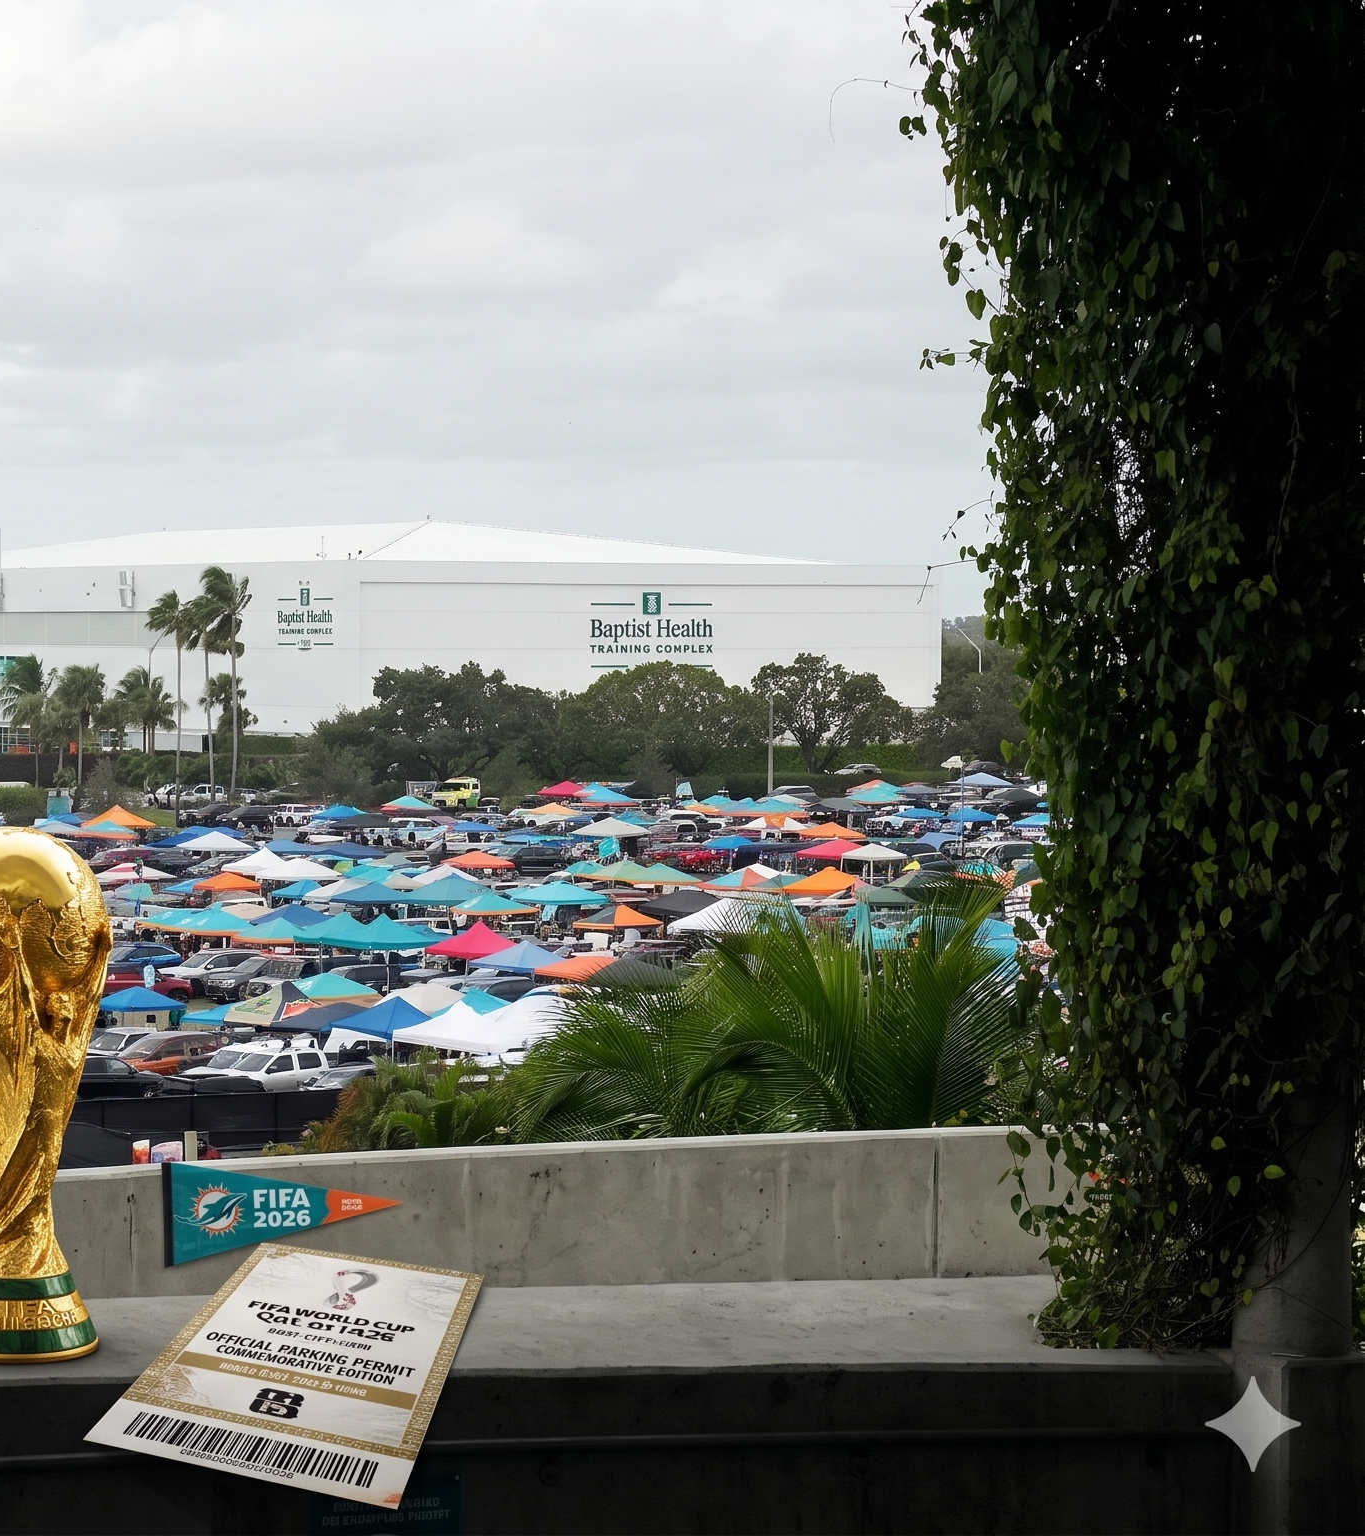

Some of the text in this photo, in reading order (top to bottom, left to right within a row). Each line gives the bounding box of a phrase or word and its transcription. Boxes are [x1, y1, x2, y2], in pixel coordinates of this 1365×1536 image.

[277, 609, 333, 627] Baptist Health
[589, 618, 713, 643] Baptist Health
[589, 644, 713, 654] TRAINING COMPLEX
[253, 1188, 311, 1209] FIFA
[253, 1209, 311, 1228] 2026
[248, 1300, 415, 1333] FIFA WORLD CUP
[206, 1331, 273, 1351] OFFICIAL
[277, 1344, 349, 1365] PARKING
[352, 1357, 416, 1378] PERMIT
[216, 1344, 335, 1374] COMMEMORATIVE
